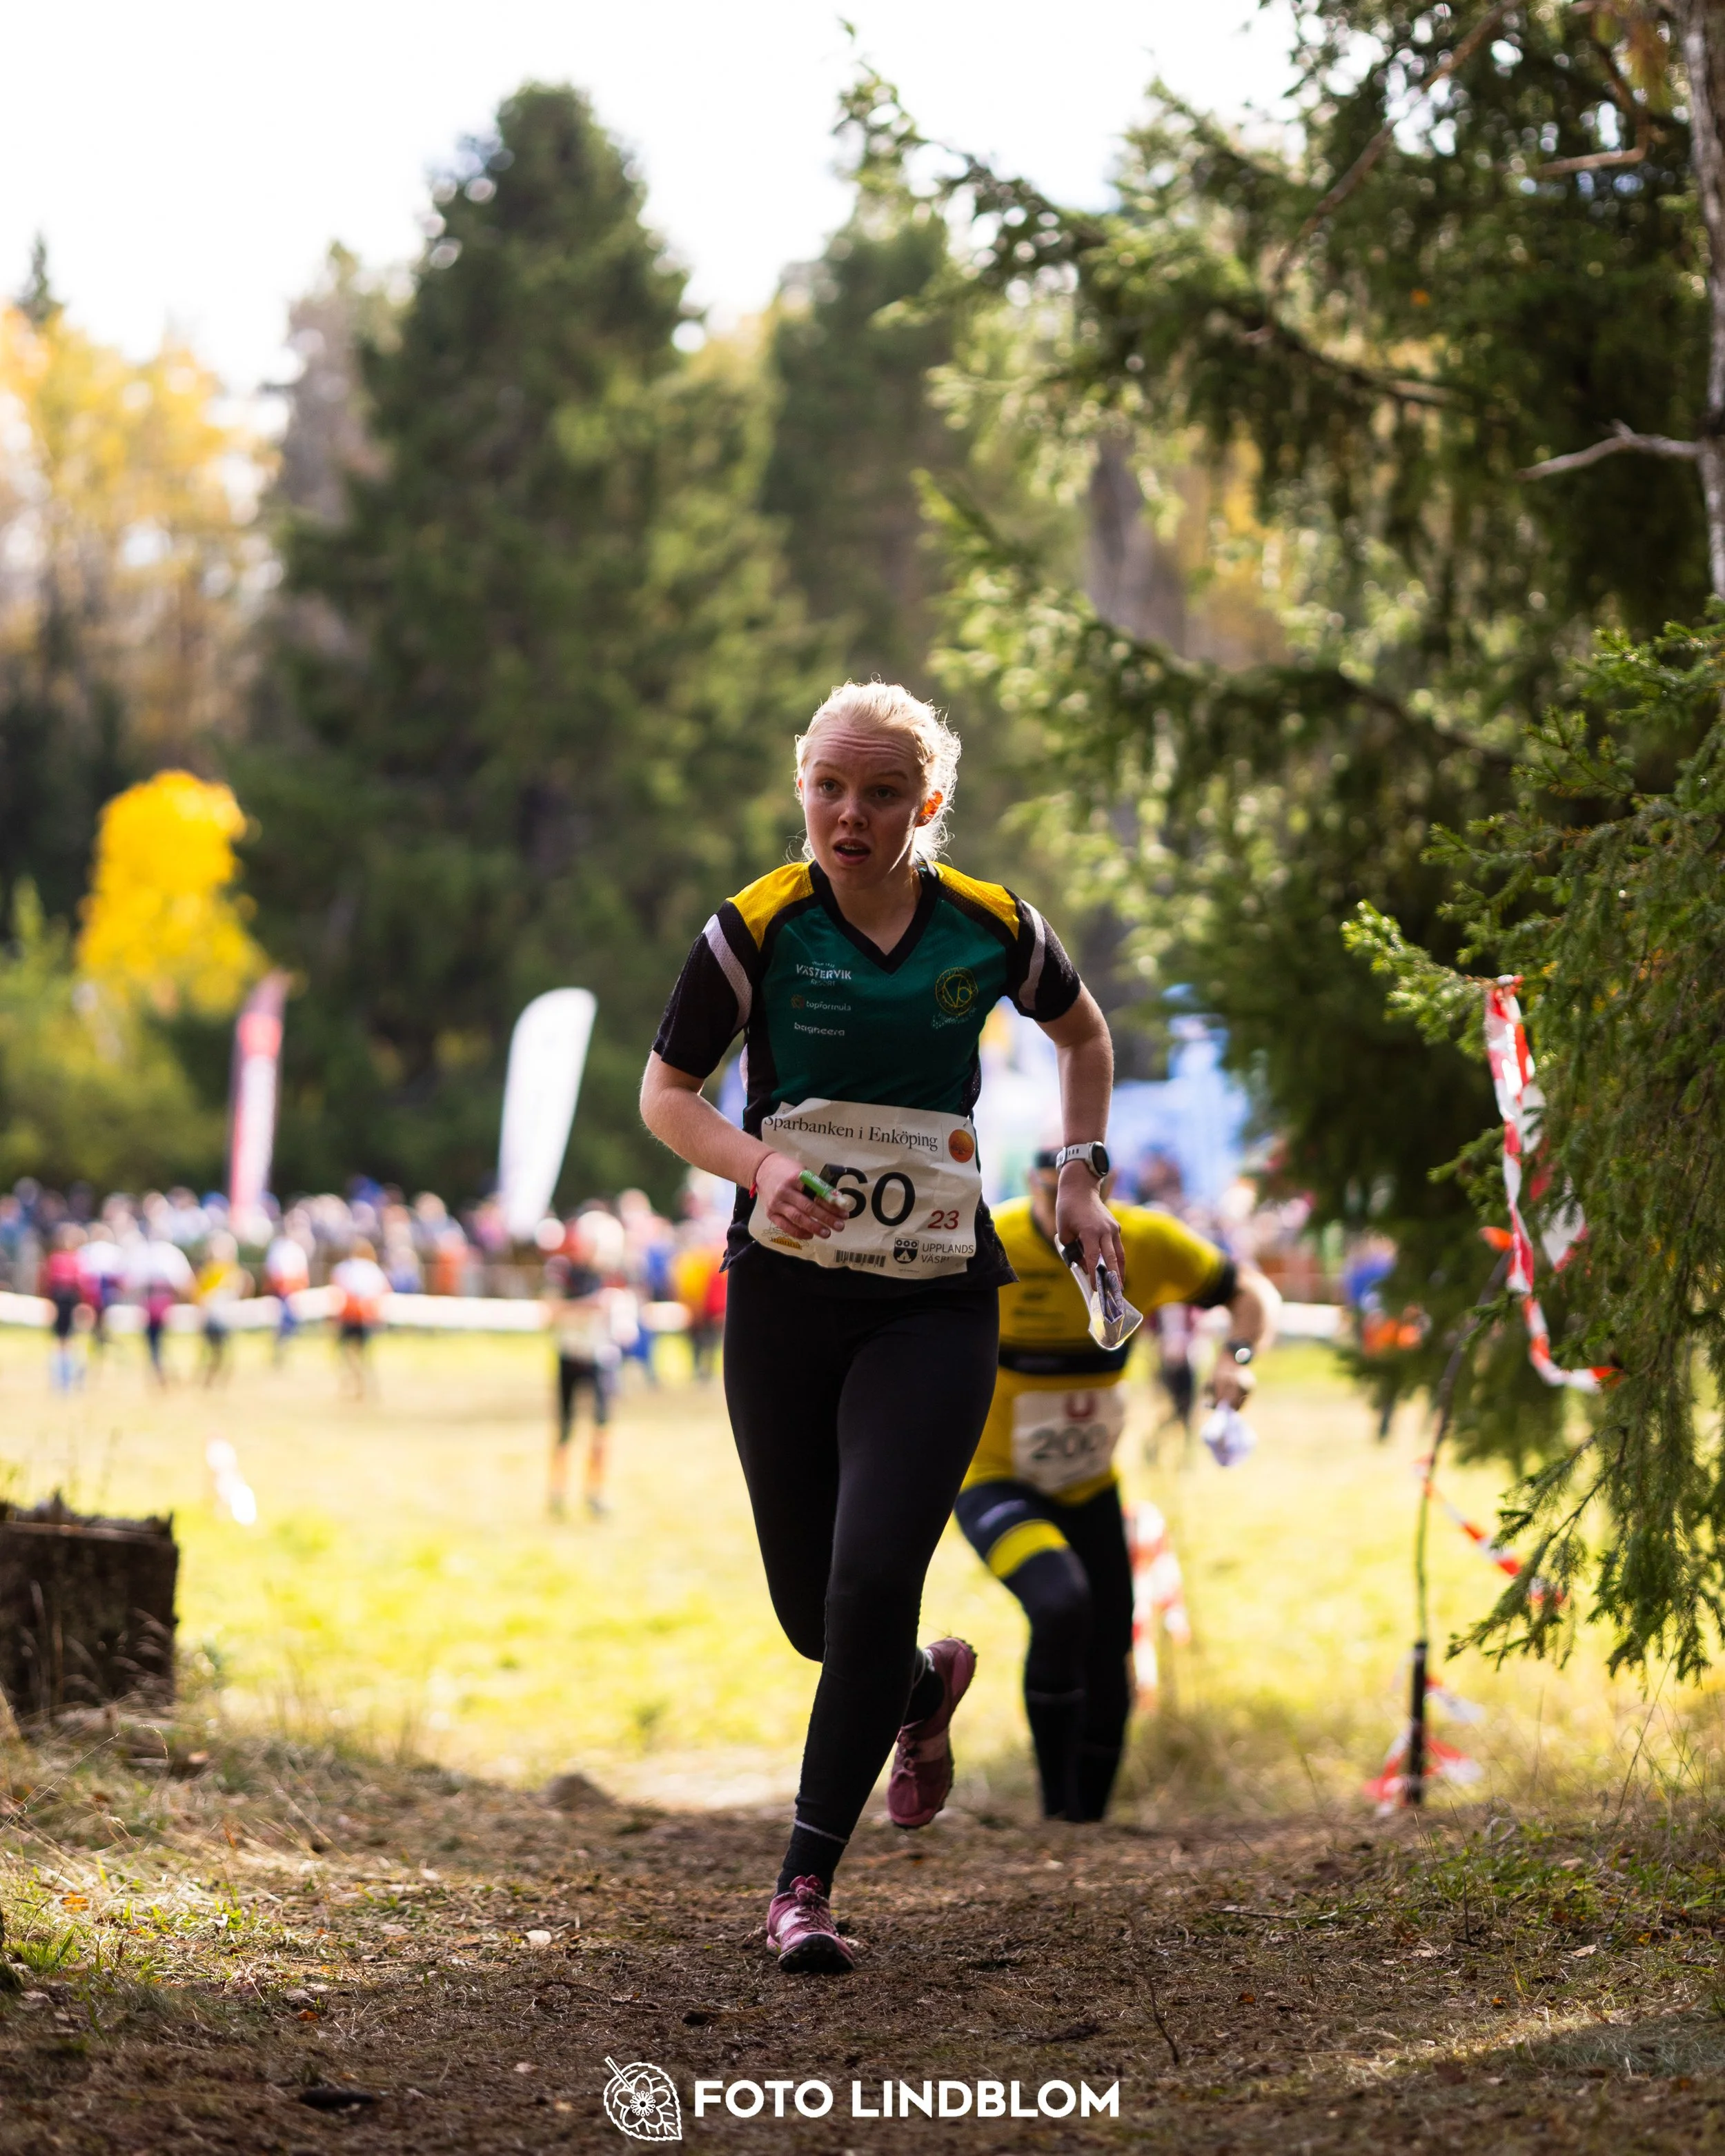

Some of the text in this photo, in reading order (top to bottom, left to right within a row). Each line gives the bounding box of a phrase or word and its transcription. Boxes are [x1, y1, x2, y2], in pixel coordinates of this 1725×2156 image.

[796, 964, 851, 980] VÄSTERVIK
[806, 1000, 851, 1011] topformula
[764, 1116, 938, 1151] Sparbanken i Enköping
[927, 1209, 960, 1230] 23
[923, 1243, 974, 1255] UPPLANDS
